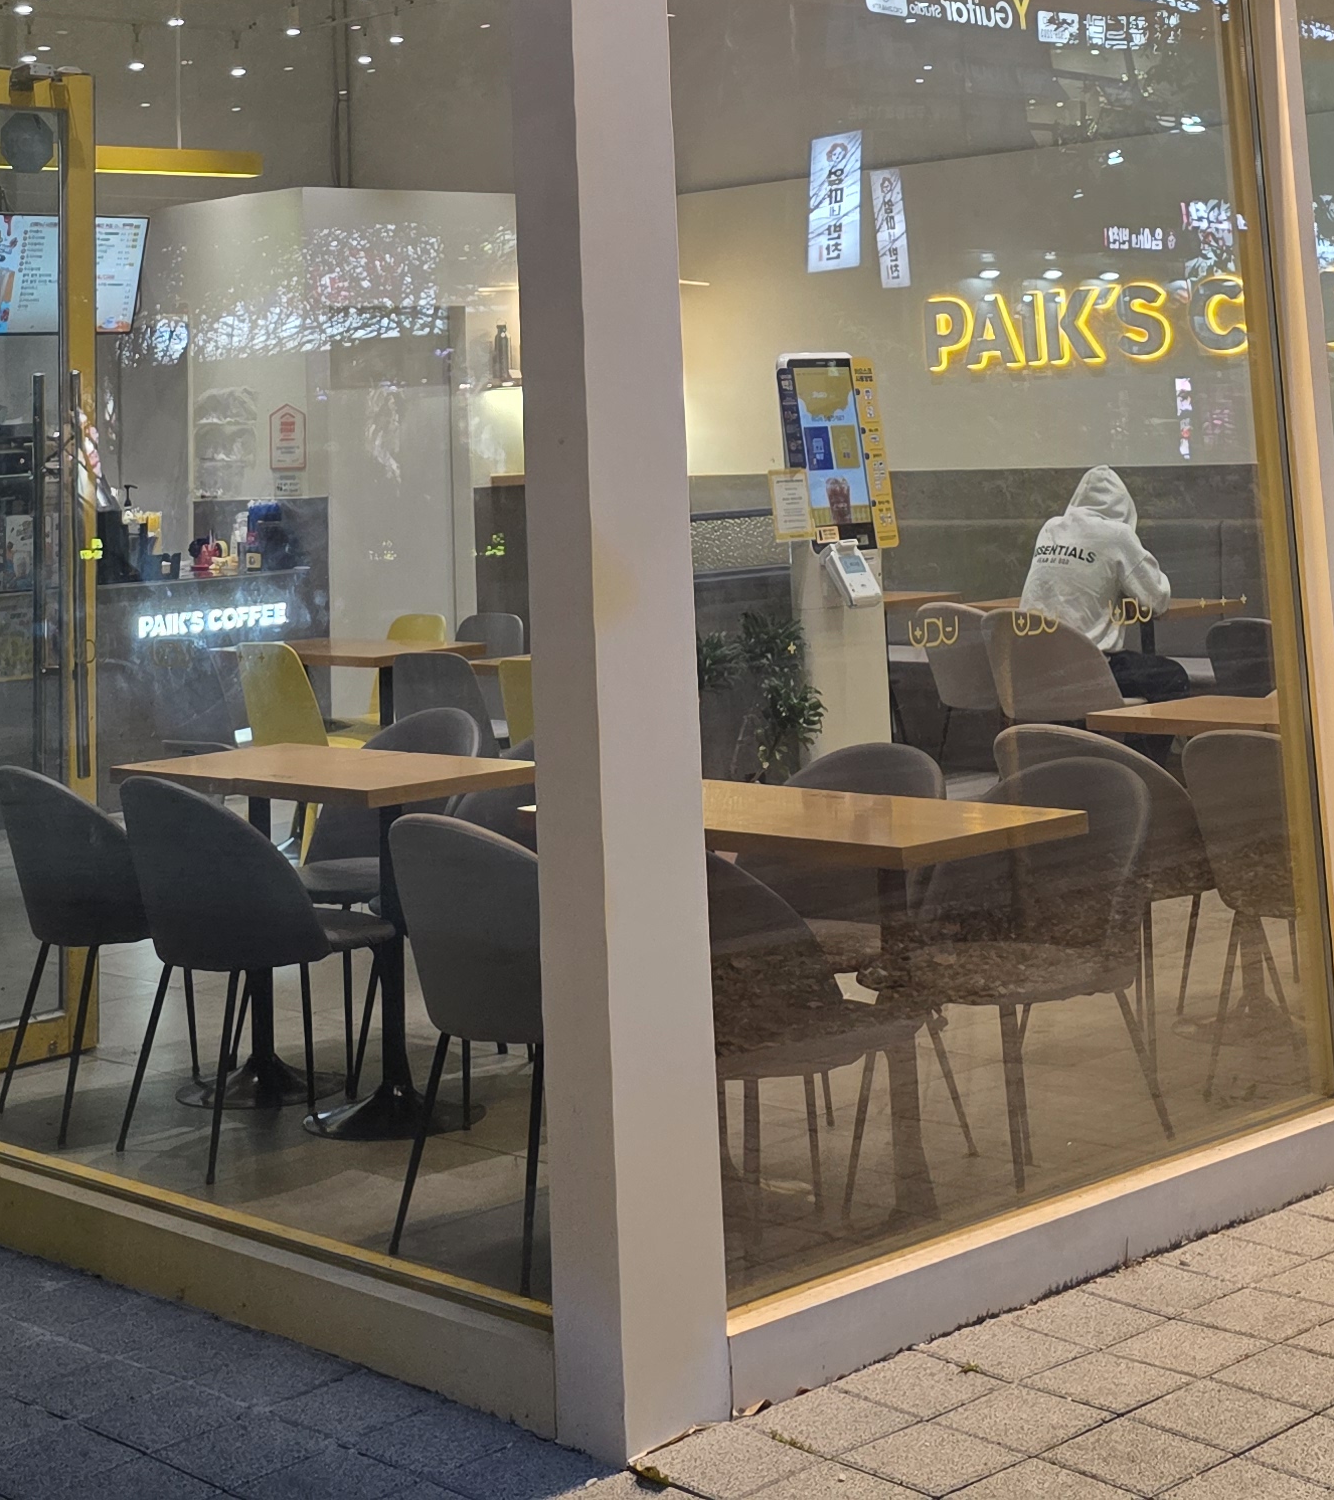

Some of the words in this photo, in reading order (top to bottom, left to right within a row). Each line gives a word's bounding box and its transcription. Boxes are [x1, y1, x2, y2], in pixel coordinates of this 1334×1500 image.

[923, 278, 1175, 375] PAIK'S
[1034, 544, 1097, 564] SSENTIALS
[138, 609, 204, 639] PAIK'S
[208, 601, 287, 631] COFFEE
